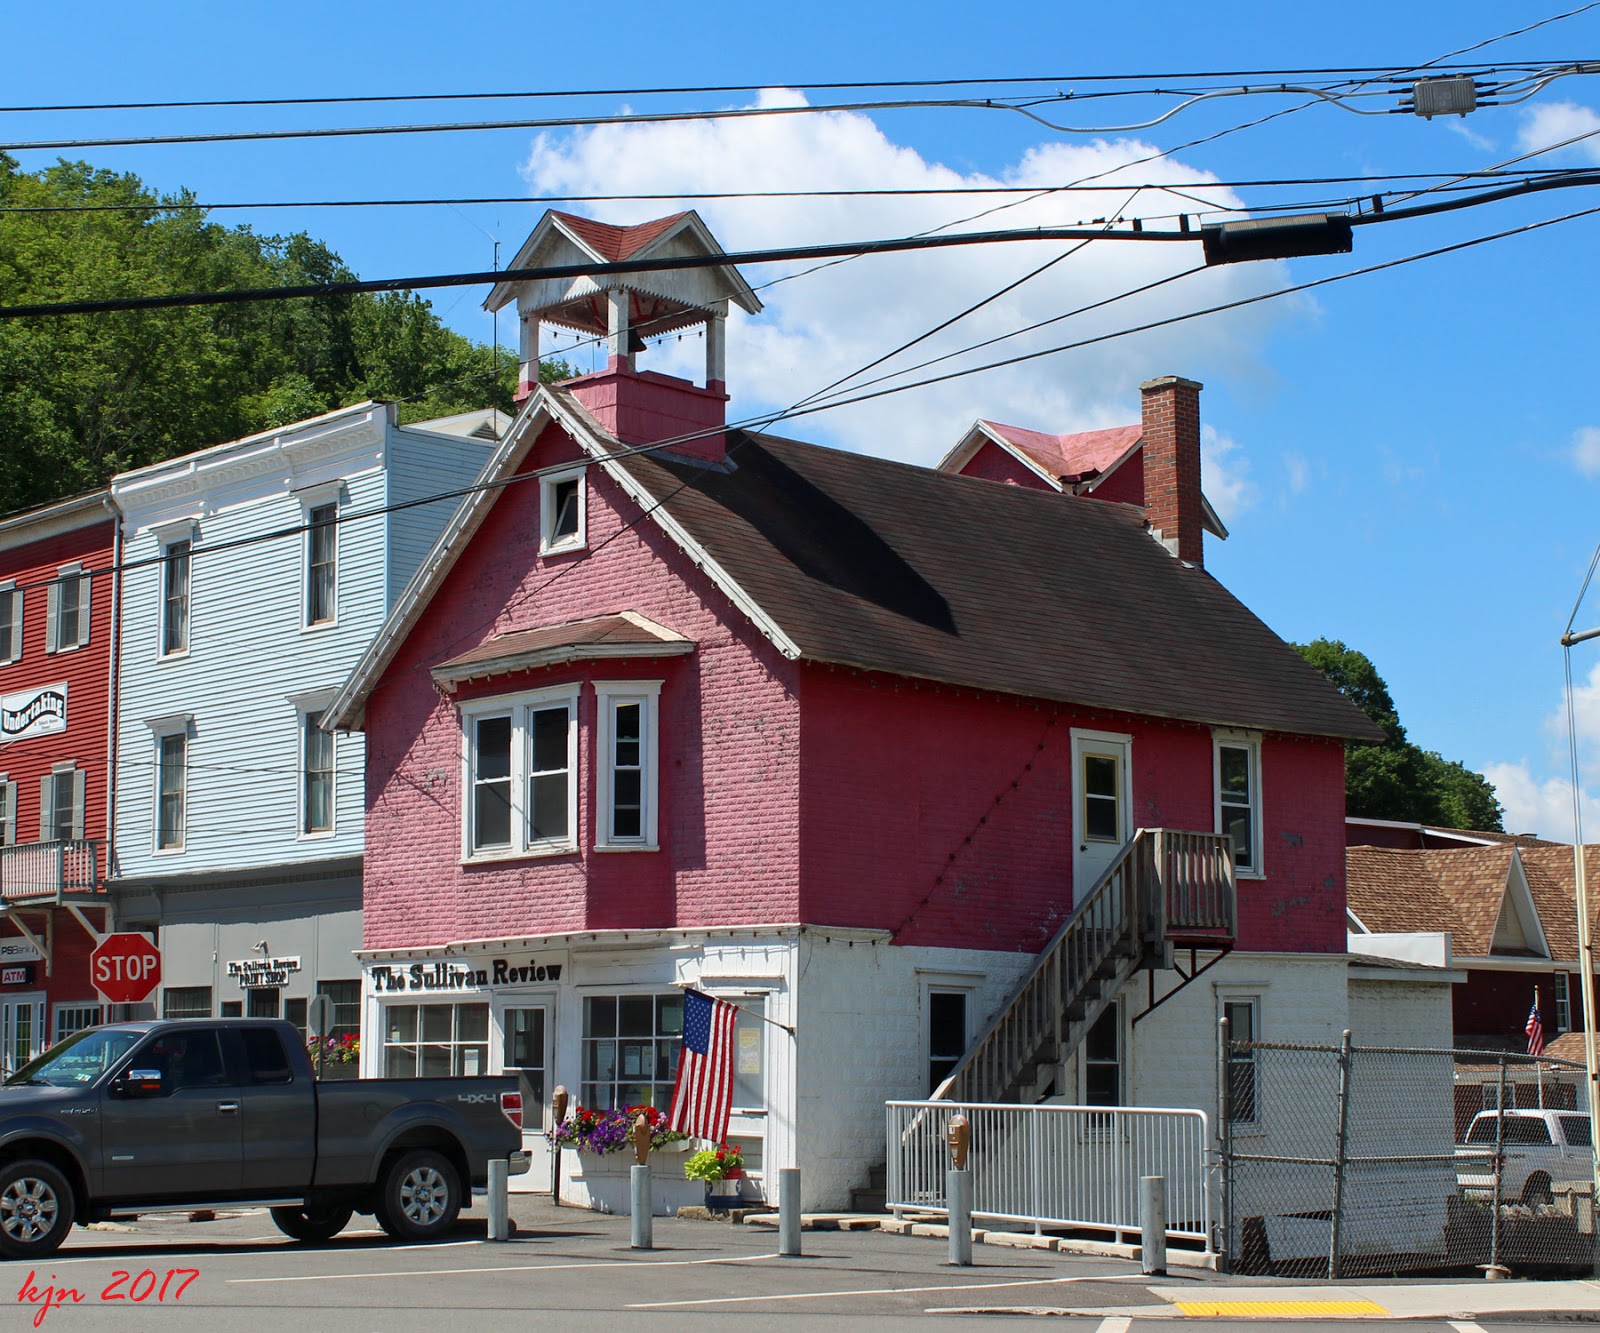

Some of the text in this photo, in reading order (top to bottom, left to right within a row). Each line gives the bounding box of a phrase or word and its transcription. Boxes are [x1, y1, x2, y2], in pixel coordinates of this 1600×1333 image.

[3, 693, 63, 730] Undertaking
[4, 971, 25, 982] ATM
[96, 954, 157, 982] STOP
[229, 963, 242, 972] The
[240, 971, 287, 985] PRINT SHOP
[372, 959, 562, 991] The Sullivan Review
